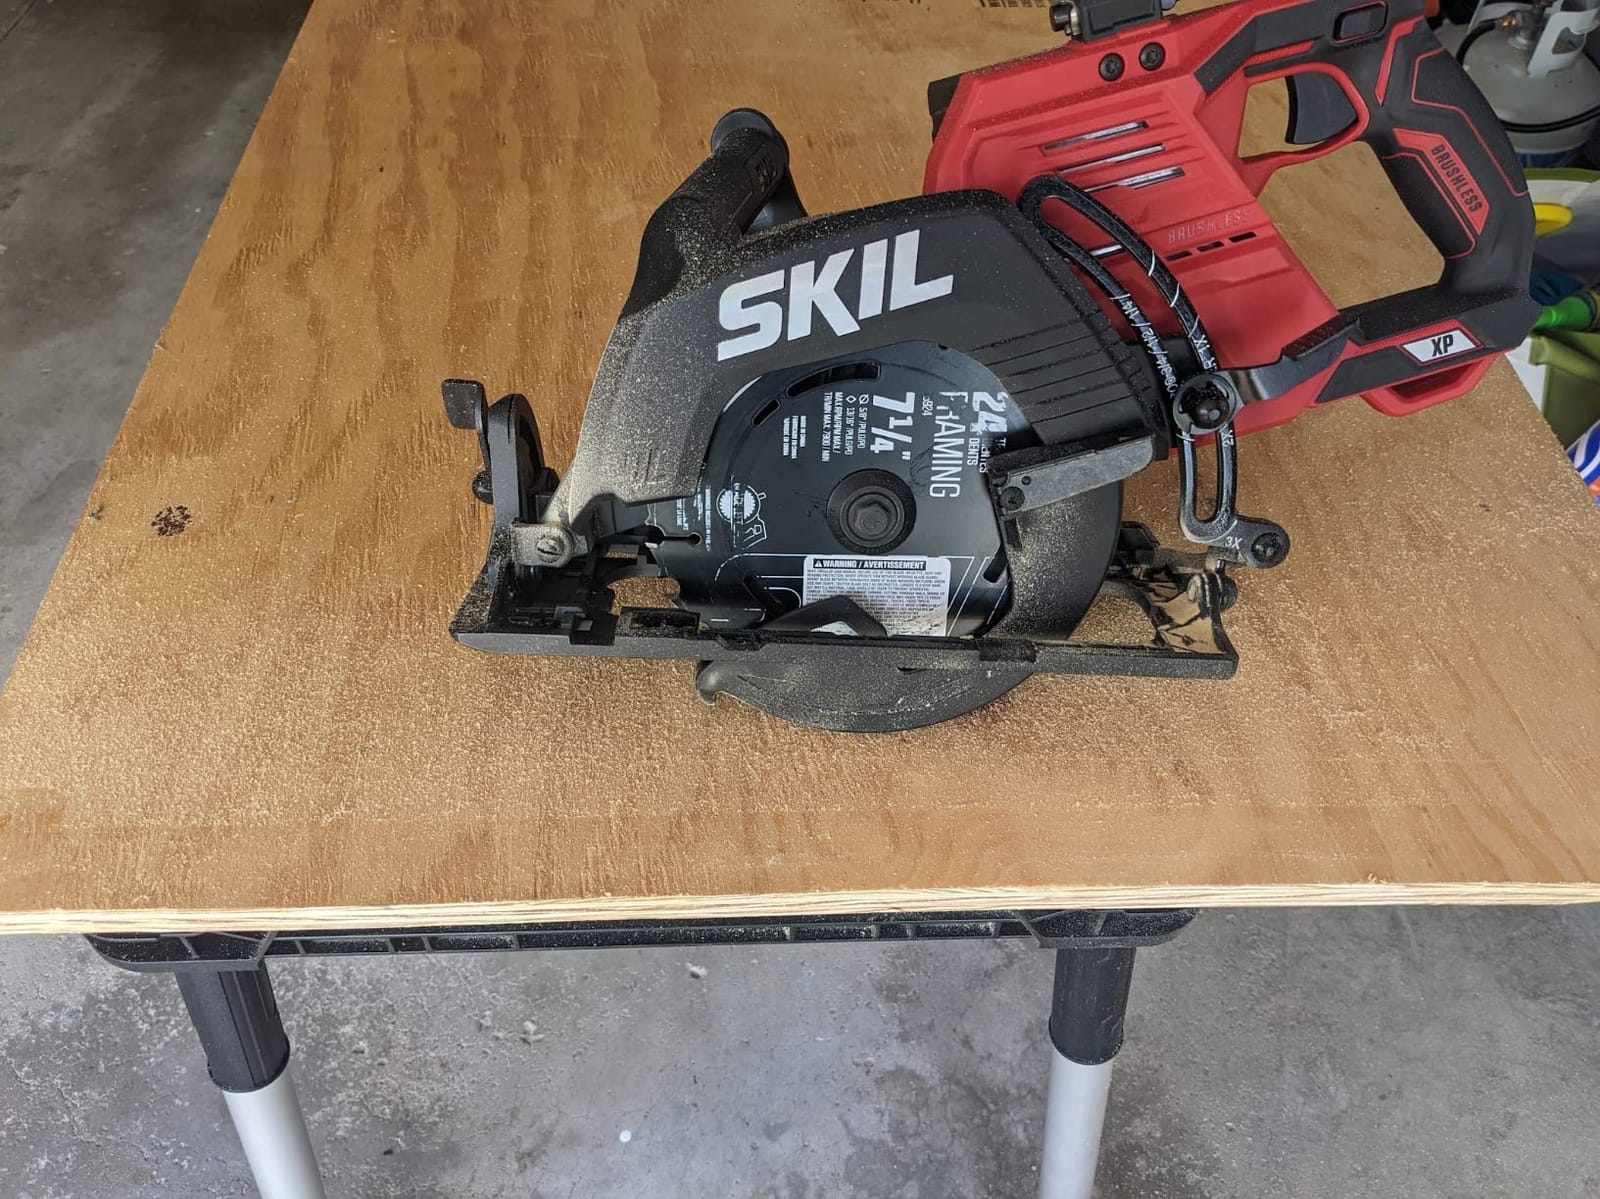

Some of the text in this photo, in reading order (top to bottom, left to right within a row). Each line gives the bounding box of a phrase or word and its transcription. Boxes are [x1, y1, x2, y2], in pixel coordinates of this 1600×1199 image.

[1431, 144, 1482, 213] BRUSHLESS
[1168, 207, 1254, 244] BRUSHES
[717, 229, 954, 362] SKIL
[1430, 334, 1454, 358] XP
[969, 391, 1008, 433] 24
[967, 438, 980, 466] DENTS
[1224, 536, 1242, 549] 3X
[822, 560, 857, 569] WARNING
[863, 561, 925, 570] AVERTISSEMENT
